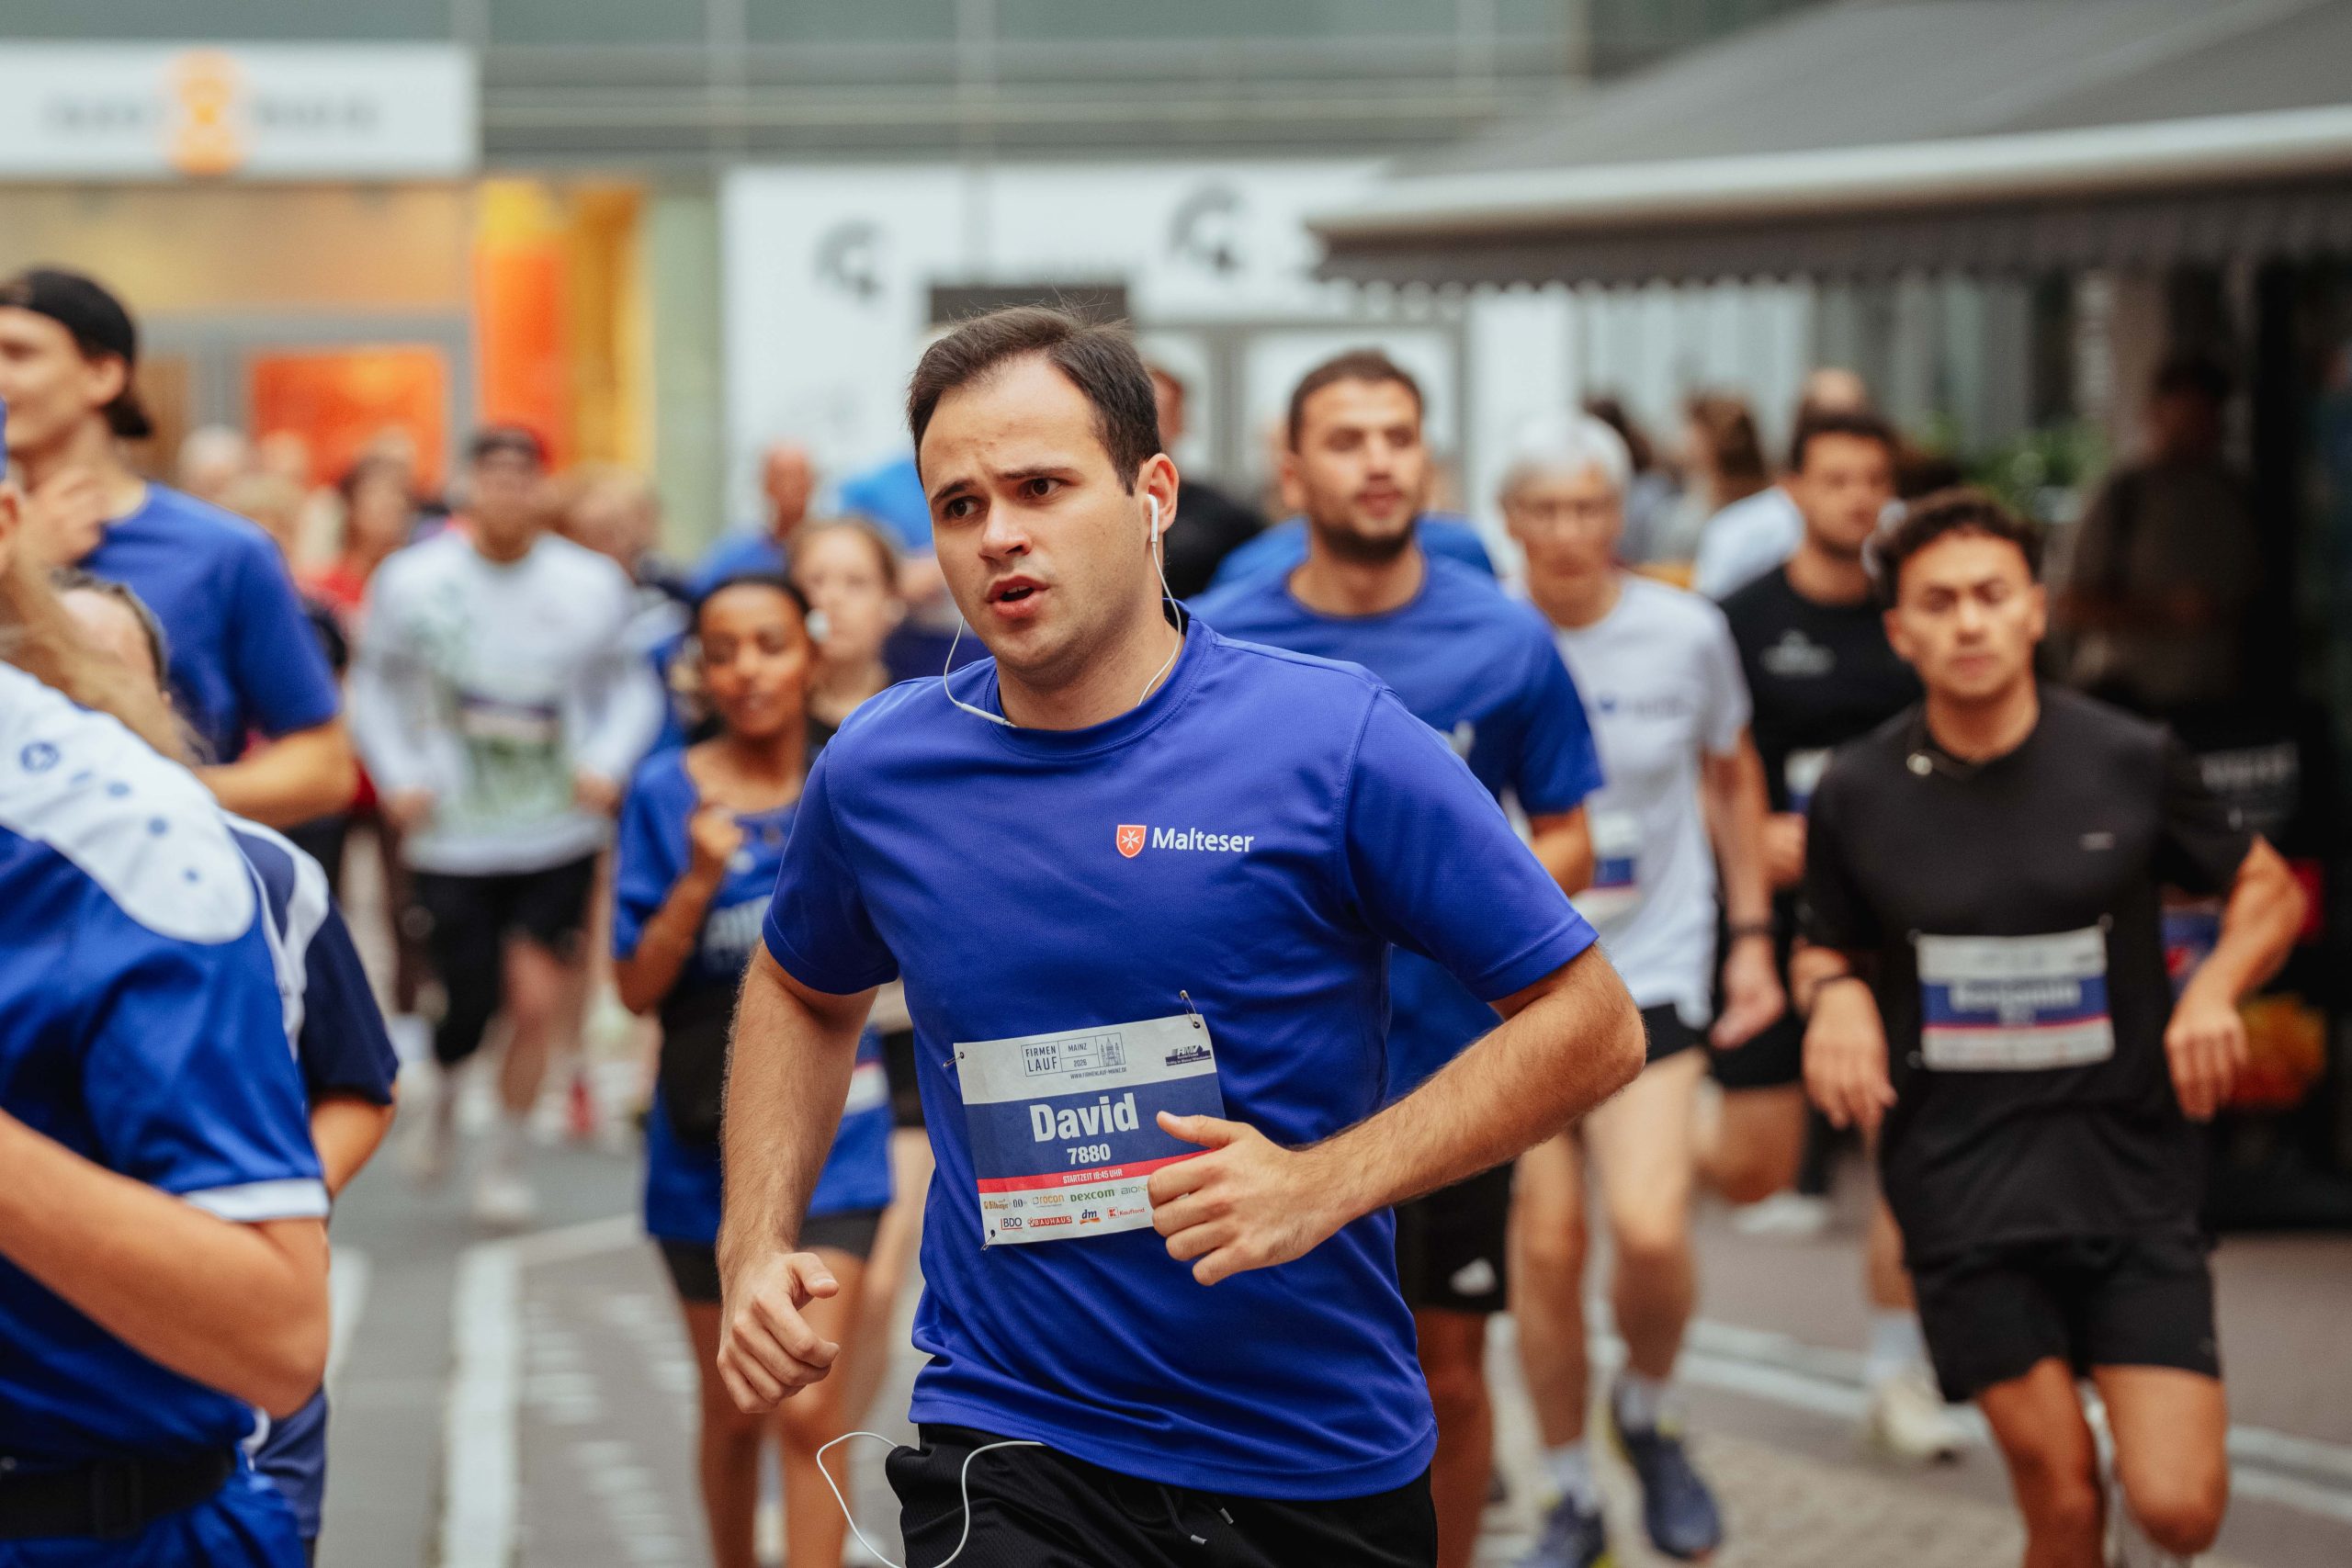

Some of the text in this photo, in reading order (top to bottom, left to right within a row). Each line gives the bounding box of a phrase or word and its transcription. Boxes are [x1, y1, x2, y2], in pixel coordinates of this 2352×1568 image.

[1152, 827, 1254, 852] Malteser
[1025, 1045, 1057, 1057] FIRMEN
[1068, 1043, 1087, 1052] MAINZ
[1027, 1056, 1057, 1072] LAUF
[1029, 1092, 1139, 1143] David
[1067, 1144, 1112, 1165] 7880
[1063, 1172, 1092, 1184] STARTZEIT
[1109, 1168, 1123, 1178] UHR
[1081, 1209, 1097, 1219] dm
[1119, 1207, 1146, 1216] Kaufland
[1003, 1217, 1023, 1227] BDO
[1035, 1216, 1072, 1226] BAUHAUS
